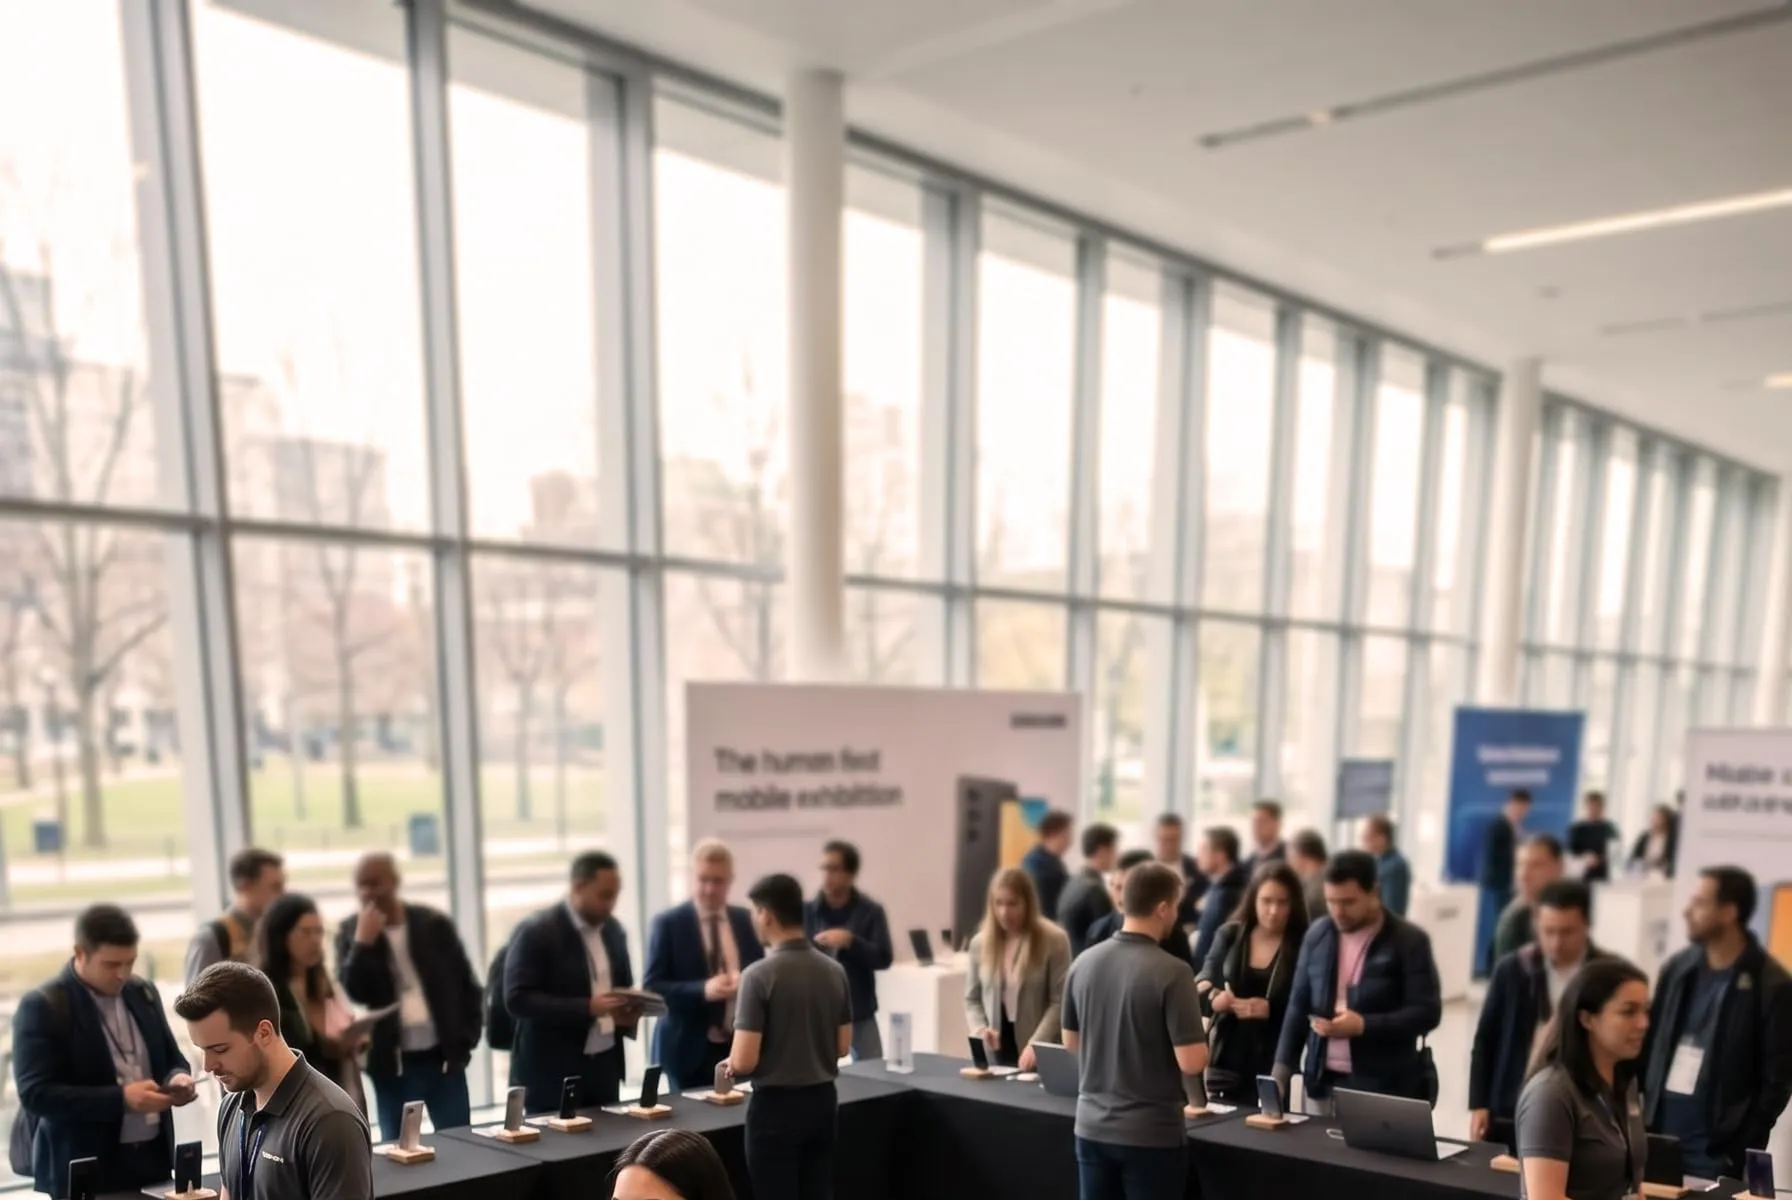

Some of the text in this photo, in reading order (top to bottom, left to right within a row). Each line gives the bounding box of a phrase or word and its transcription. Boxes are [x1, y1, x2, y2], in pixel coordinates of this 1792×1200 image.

[715, 747, 755, 774] The
[762, 748, 834, 775] human
[715, 785, 791, 813] mobile
